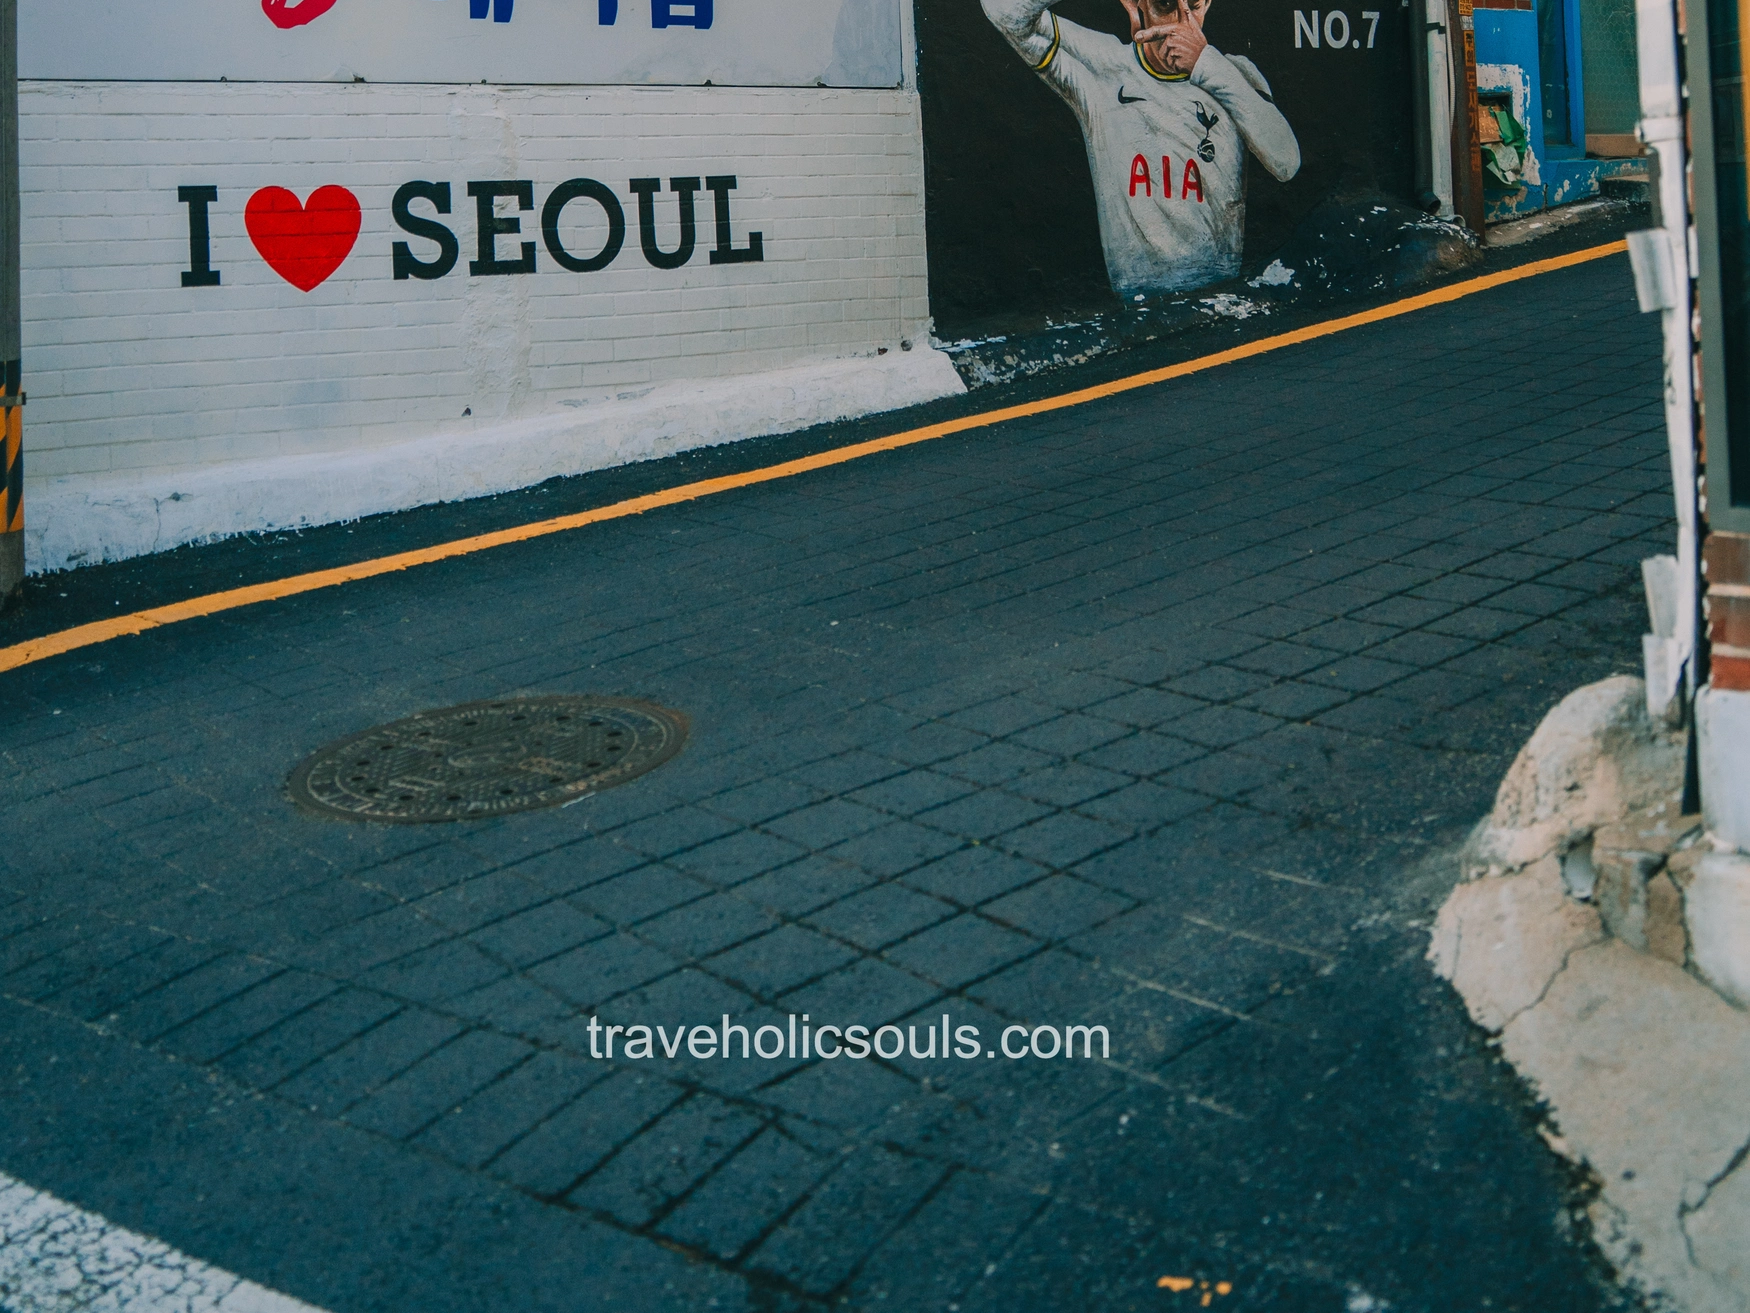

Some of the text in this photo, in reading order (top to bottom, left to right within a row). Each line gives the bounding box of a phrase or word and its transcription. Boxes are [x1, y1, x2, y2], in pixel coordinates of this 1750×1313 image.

[1293, 9, 1380, 49] NO.7
[1128, 153, 1204, 203] AIA
[177, 174, 765, 288] I SEOUL
